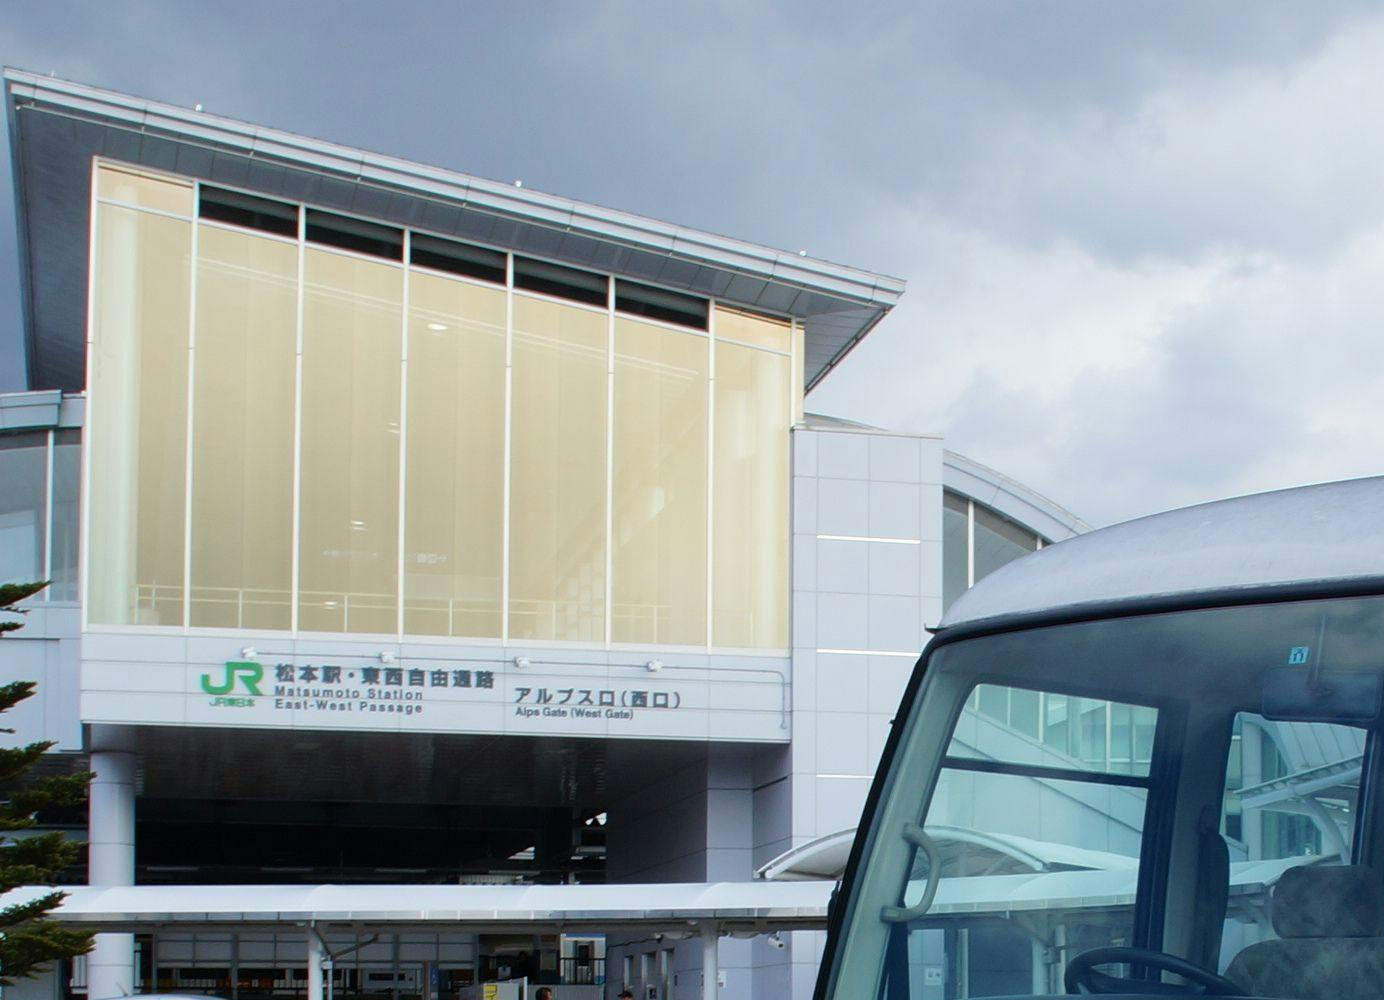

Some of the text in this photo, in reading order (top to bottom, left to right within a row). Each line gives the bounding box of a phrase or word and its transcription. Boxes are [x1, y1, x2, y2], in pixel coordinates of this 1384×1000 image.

[201, 661, 264, 696] JR
[275, 686, 423, 700] Matsumoto Station
[275, 699, 423, 715] East-West Passage
[515, 706, 540, 718] Alps
[542, 707, 568, 717] Gate
